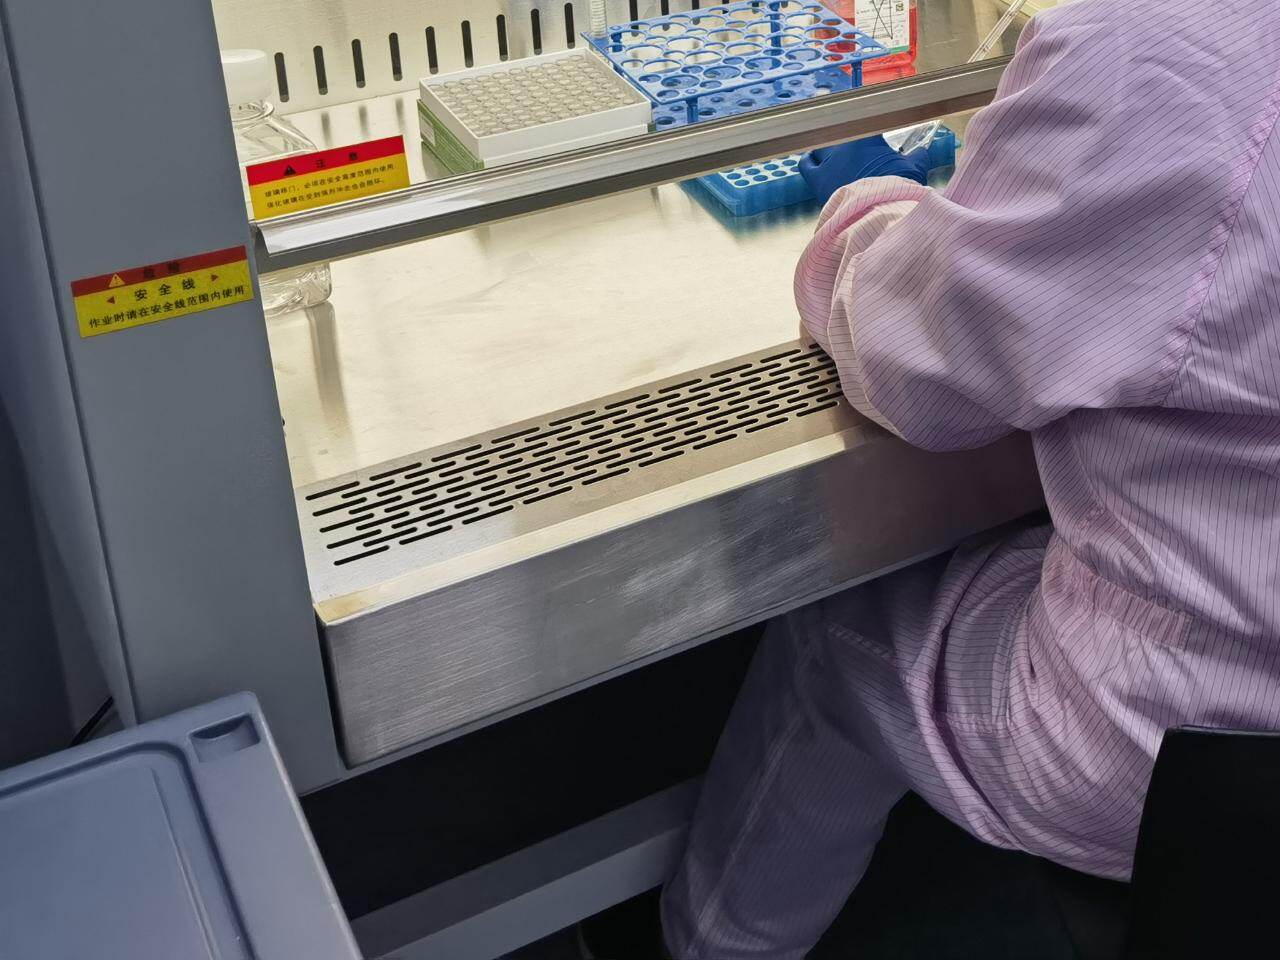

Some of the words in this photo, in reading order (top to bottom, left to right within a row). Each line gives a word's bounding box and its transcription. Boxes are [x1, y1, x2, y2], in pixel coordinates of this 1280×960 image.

[134, 278, 196, 301] 安全线
[89, 286, 245, 328] 作业时请在安全线范围内使用
